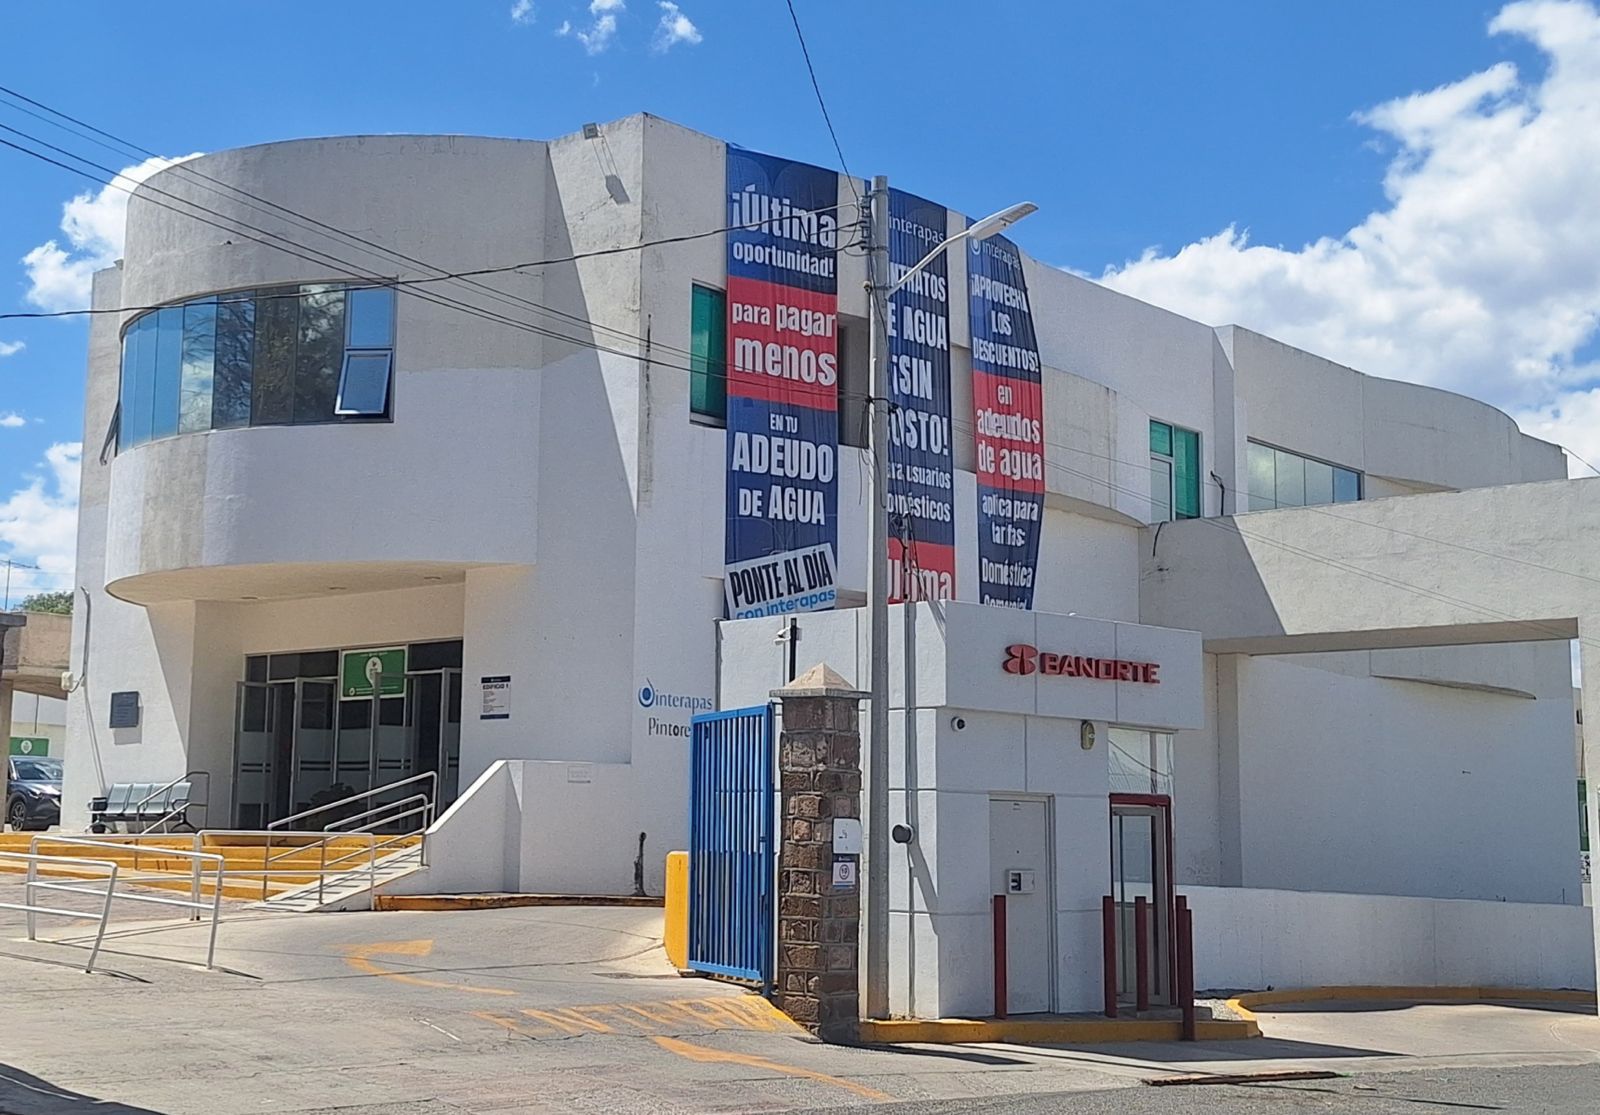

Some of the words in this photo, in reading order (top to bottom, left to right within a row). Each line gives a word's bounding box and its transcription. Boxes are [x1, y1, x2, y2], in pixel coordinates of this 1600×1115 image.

[732, 184, 836, 249] ¡Última
[888, 211, 944, 247] interapas
[733, 242, 834, 278] oportunidad!
[889, 262, 946, 302] NTRATOS
[972, 273, 1029, 313] ¡APROVECHA
[732, 303, 770, 325] para
[776, 303, 836, 337] pagar
[887, 301, 897, 337] E
[904, 306, 947, 351] AGUA
[991, 311, 1012, 336] LOS
[735, 338, 836, 386] menos
[973, 337, 1040, 372] DESCUENTOS!
[892, 355, 932, 399] ¡SIN
[998, 384, 1012, 406] en
[770, 413, 780, 430] EN
[786, 415, 797, 433] TU
[889, 407, 948, 456] OSTO!
[977, 408, 1040, 444] adeudos
[732, 432, 834, 483] ADEUDO
[978, 440, 995, 474] de
[1001, 448, 1043, 480] agua
[906, 465, 951, 489] usuarios
[739, 488, 762, 517] DE
[768, 485, 825, 525] AGUA
[887, 491, 951, 522] omésticos
[982, 494, 1012, 518] aplica
[1013, 500, 1038, 521] para
[729, 562, 784, 608] PONTE
[784, 558, 804, 595] AL
[802, 549, 833, 590] DÍA
[982, 558, 1033, 588] Doméstica
[737, 607, 763, 619] con
[766, 589, 836, 616] interapas
[1040, 653, 1160, 684] BANORTE
[655, 689, 712, 715] interapas
[648, 717, 692, 738] Pintore
